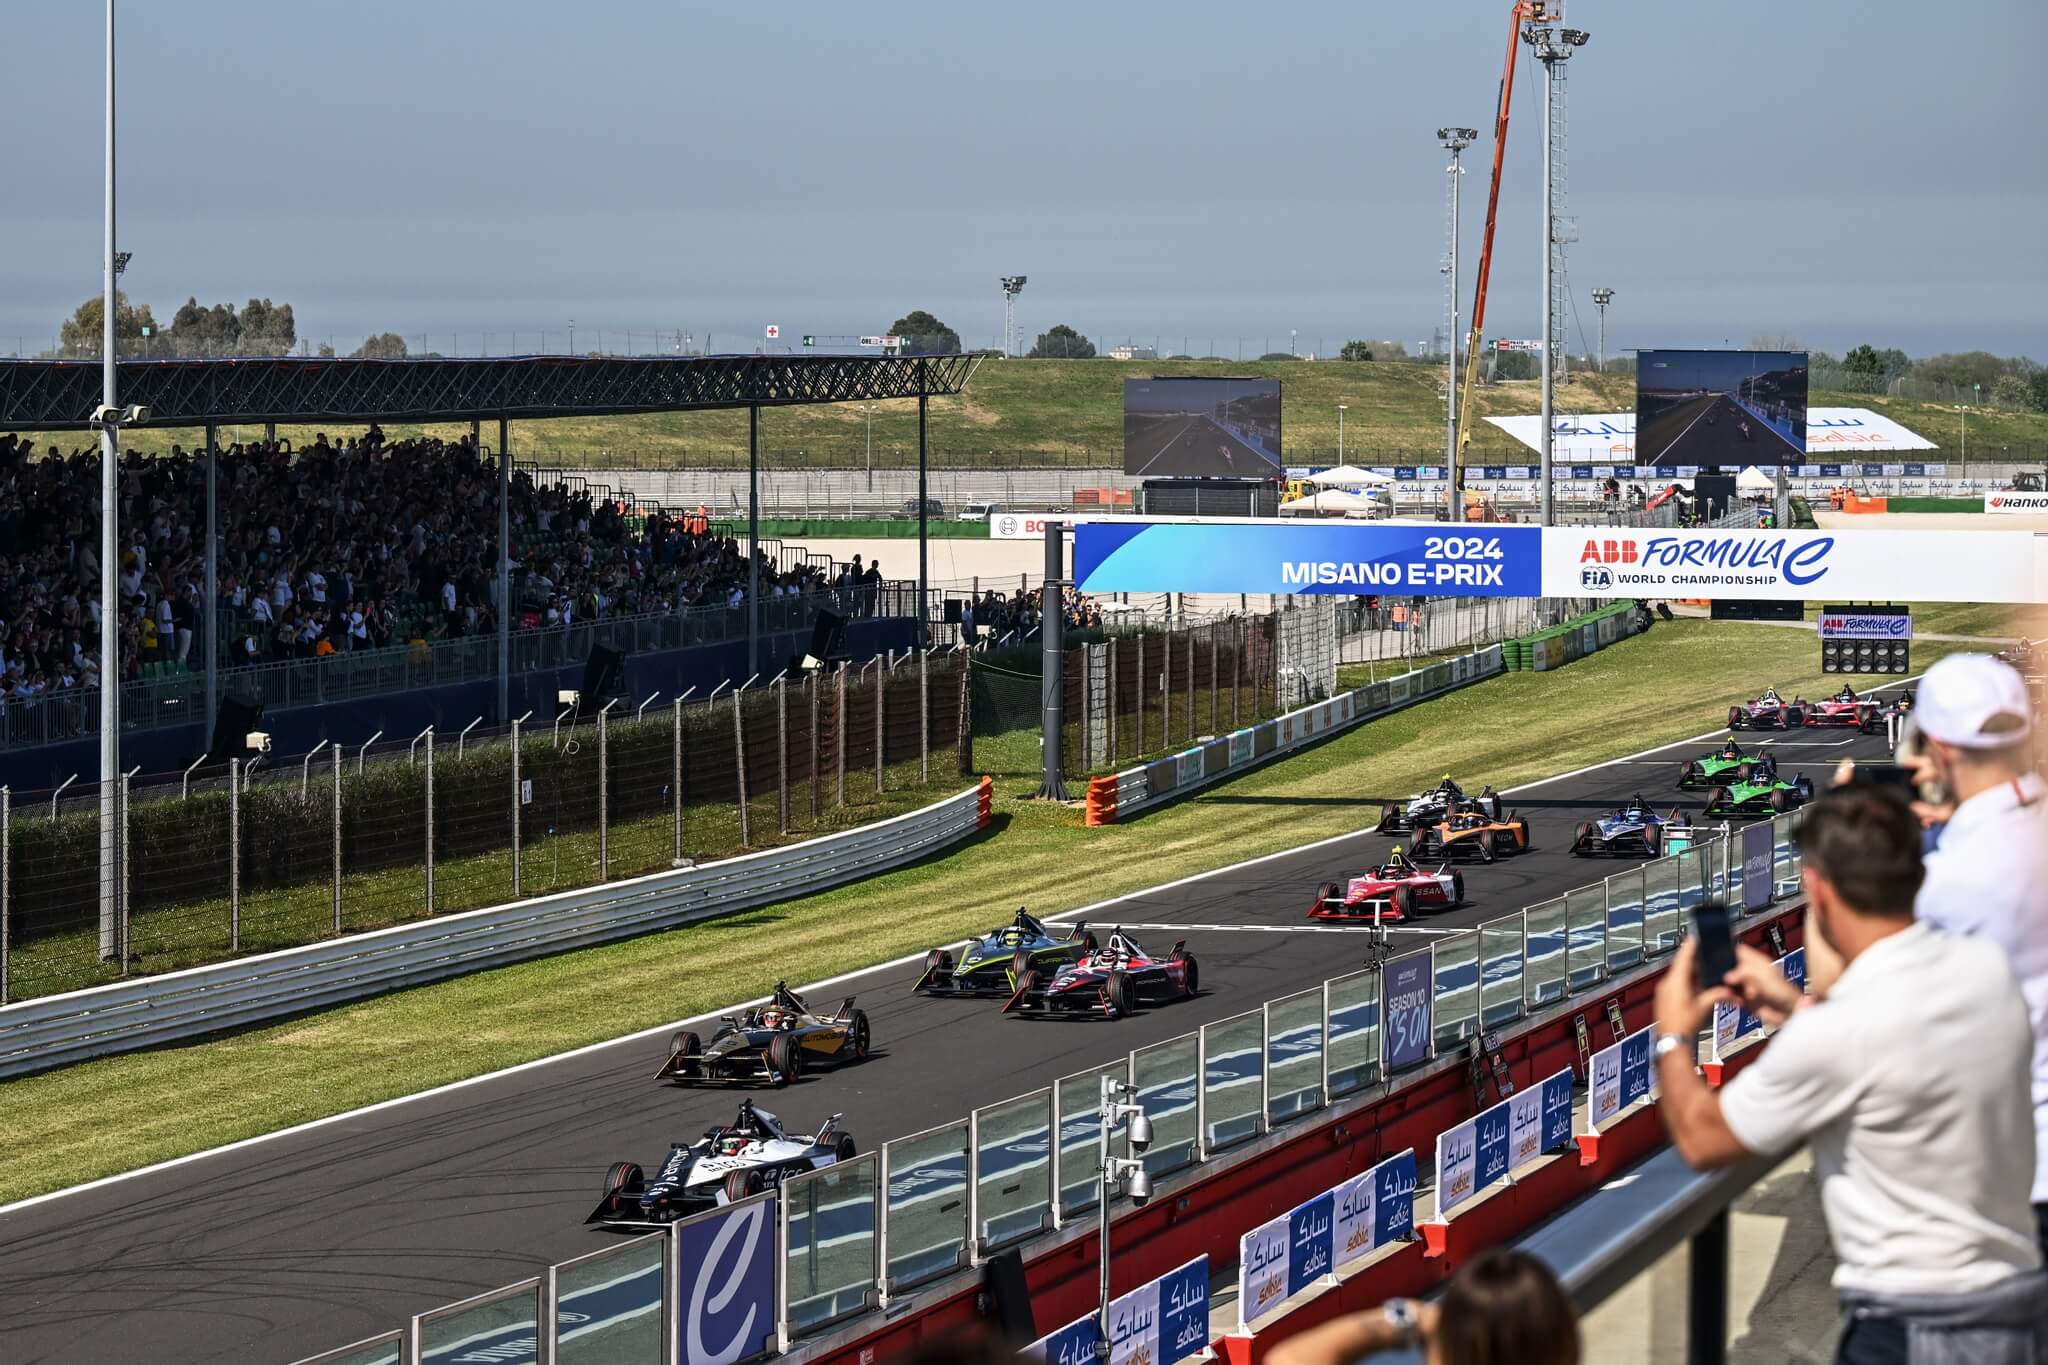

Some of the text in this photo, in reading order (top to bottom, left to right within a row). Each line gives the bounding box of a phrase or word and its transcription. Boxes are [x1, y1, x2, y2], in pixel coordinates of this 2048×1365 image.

[1424, 536, 1504, 560] 2024
[1580, 539, 1638, 564] ABB
[1641, 537, 1787, 569] FORMULA
[1281, 561, 1504, 586] MISANO E-PRIX
[1617, 575, 1666, 585] WORLD
[1671, 574, 1777, 586] CHAMPIONSHIP
[1824, 619, 1843, 628] ABB
[1844, 618, 1890, 629] FORMULA
[1389, 988, 1425, 1015] SEASON 10
[1410, 1002, 1431, 1048] ON
[1176, 1314, 1204, 1350] sabic
